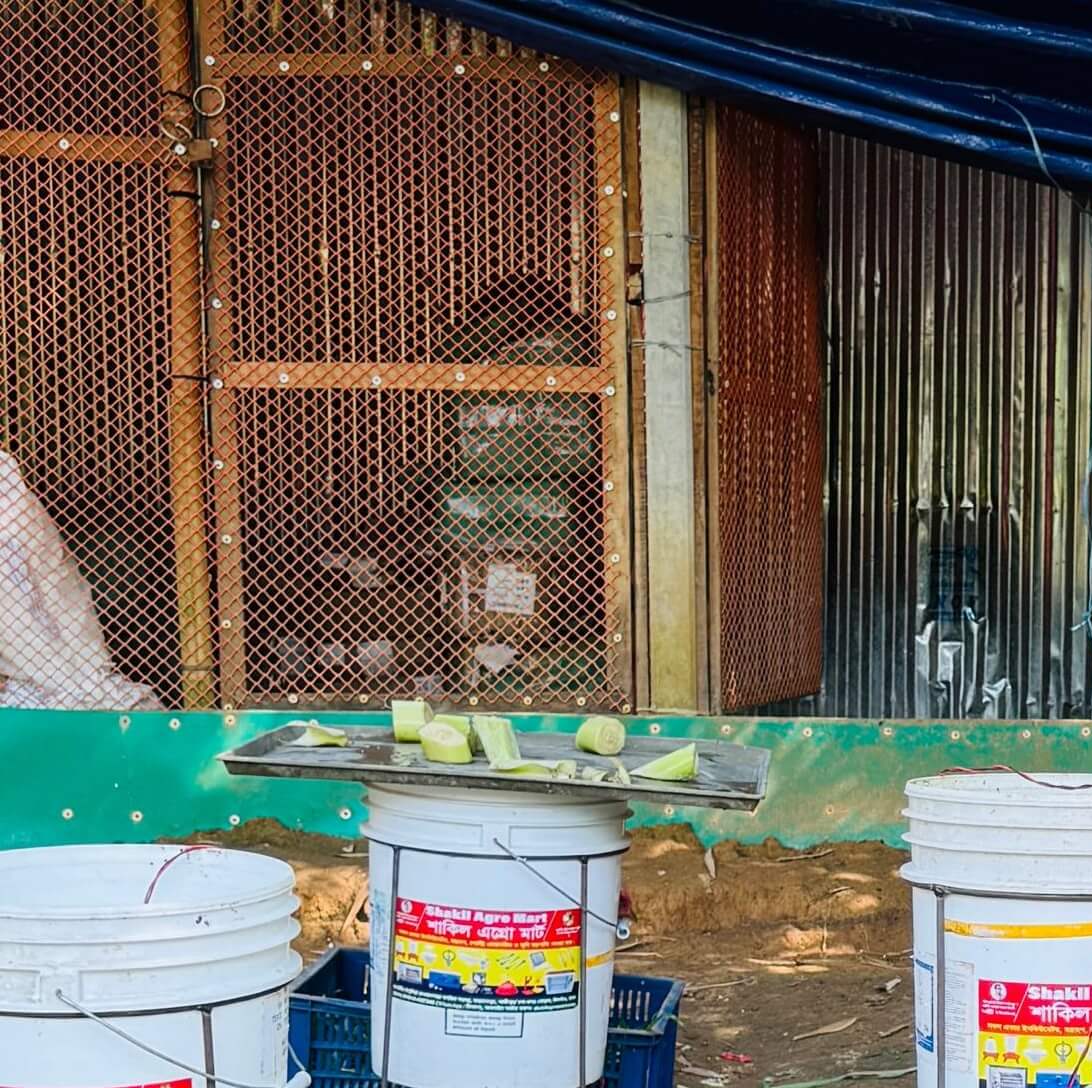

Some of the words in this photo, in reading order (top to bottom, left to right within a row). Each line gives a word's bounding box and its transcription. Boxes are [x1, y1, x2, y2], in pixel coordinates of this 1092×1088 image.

[425, 905, 472, 921] Shakil
[473, 911, 511, 925] Agro
[513, 912, 548, 924] Mart
[425, 919, 473, 938] শাকিল
[518, 924, 548, 941] মার্ট
[1027, 985, 1091, 1001] Shakil
